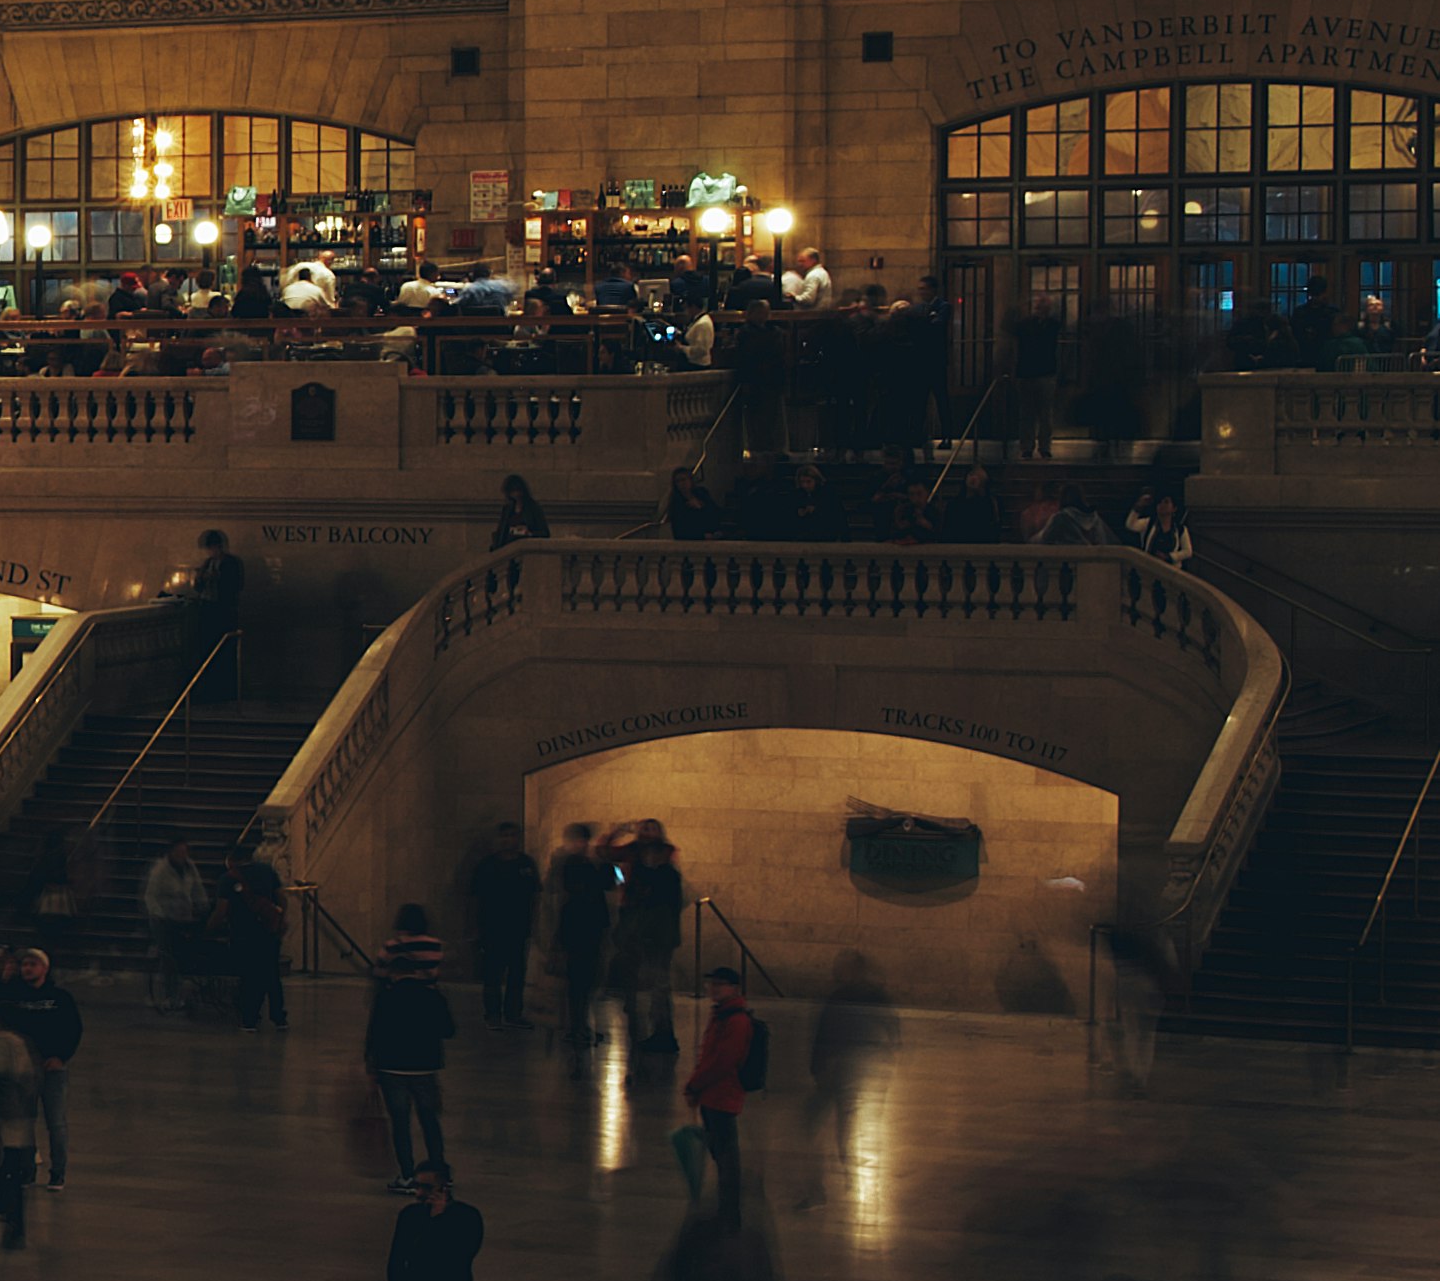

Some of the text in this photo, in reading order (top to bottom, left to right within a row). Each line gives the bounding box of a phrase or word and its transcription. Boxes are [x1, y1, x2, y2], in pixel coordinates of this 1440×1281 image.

[993, 14, 1440, 65] TO VANDERBILT AVENUE
[966, 66, 1036, 100] THE
[1056, 43, 1233, 79] CAMPBELL
[166, 203, 189, 220] EXIT
[262, 526, 433, 544] WEST BALCONY
[36, 570, 71, 595] ST
[537, 703, 749, 756] DINING CONCOURSE
[881, 707, 1068, 761] TRACKS 100 TO 117
[865, 841, 957, 863] DINING
